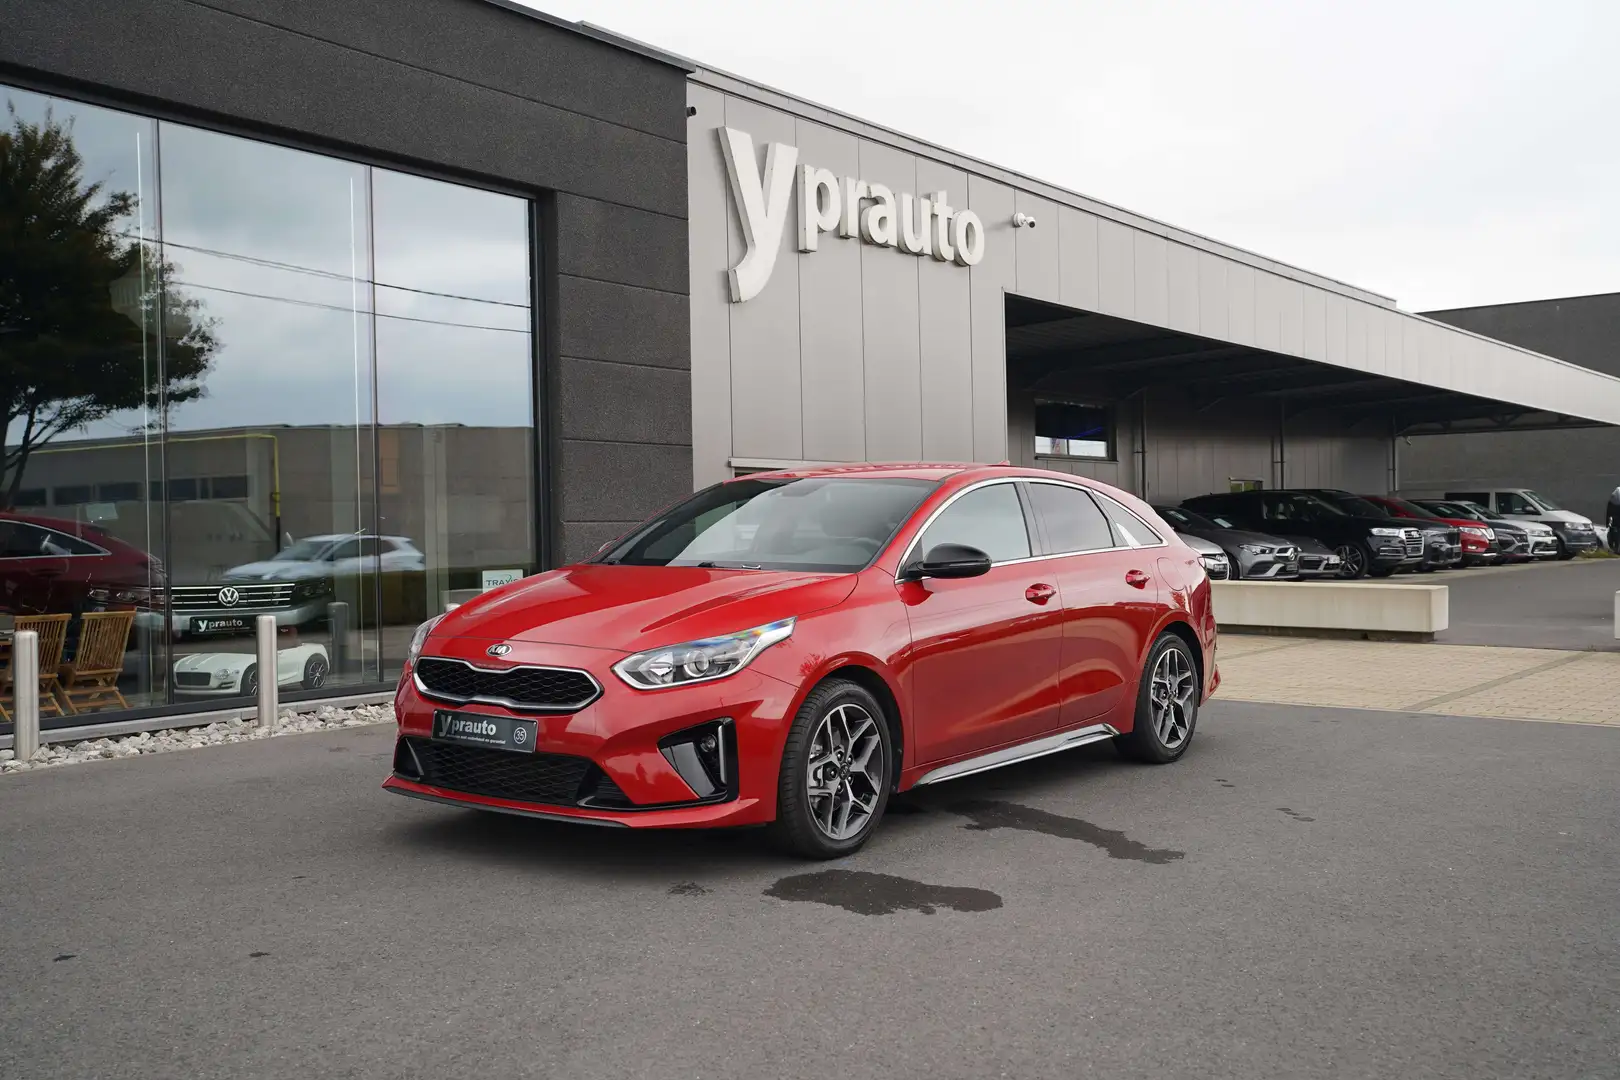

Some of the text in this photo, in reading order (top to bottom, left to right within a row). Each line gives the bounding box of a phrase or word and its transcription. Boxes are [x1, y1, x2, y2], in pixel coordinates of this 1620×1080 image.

[485, 578, 518, 586] TRA
[487, 645, 509, 655] KIA
[515, 730, 525, 741] 35
